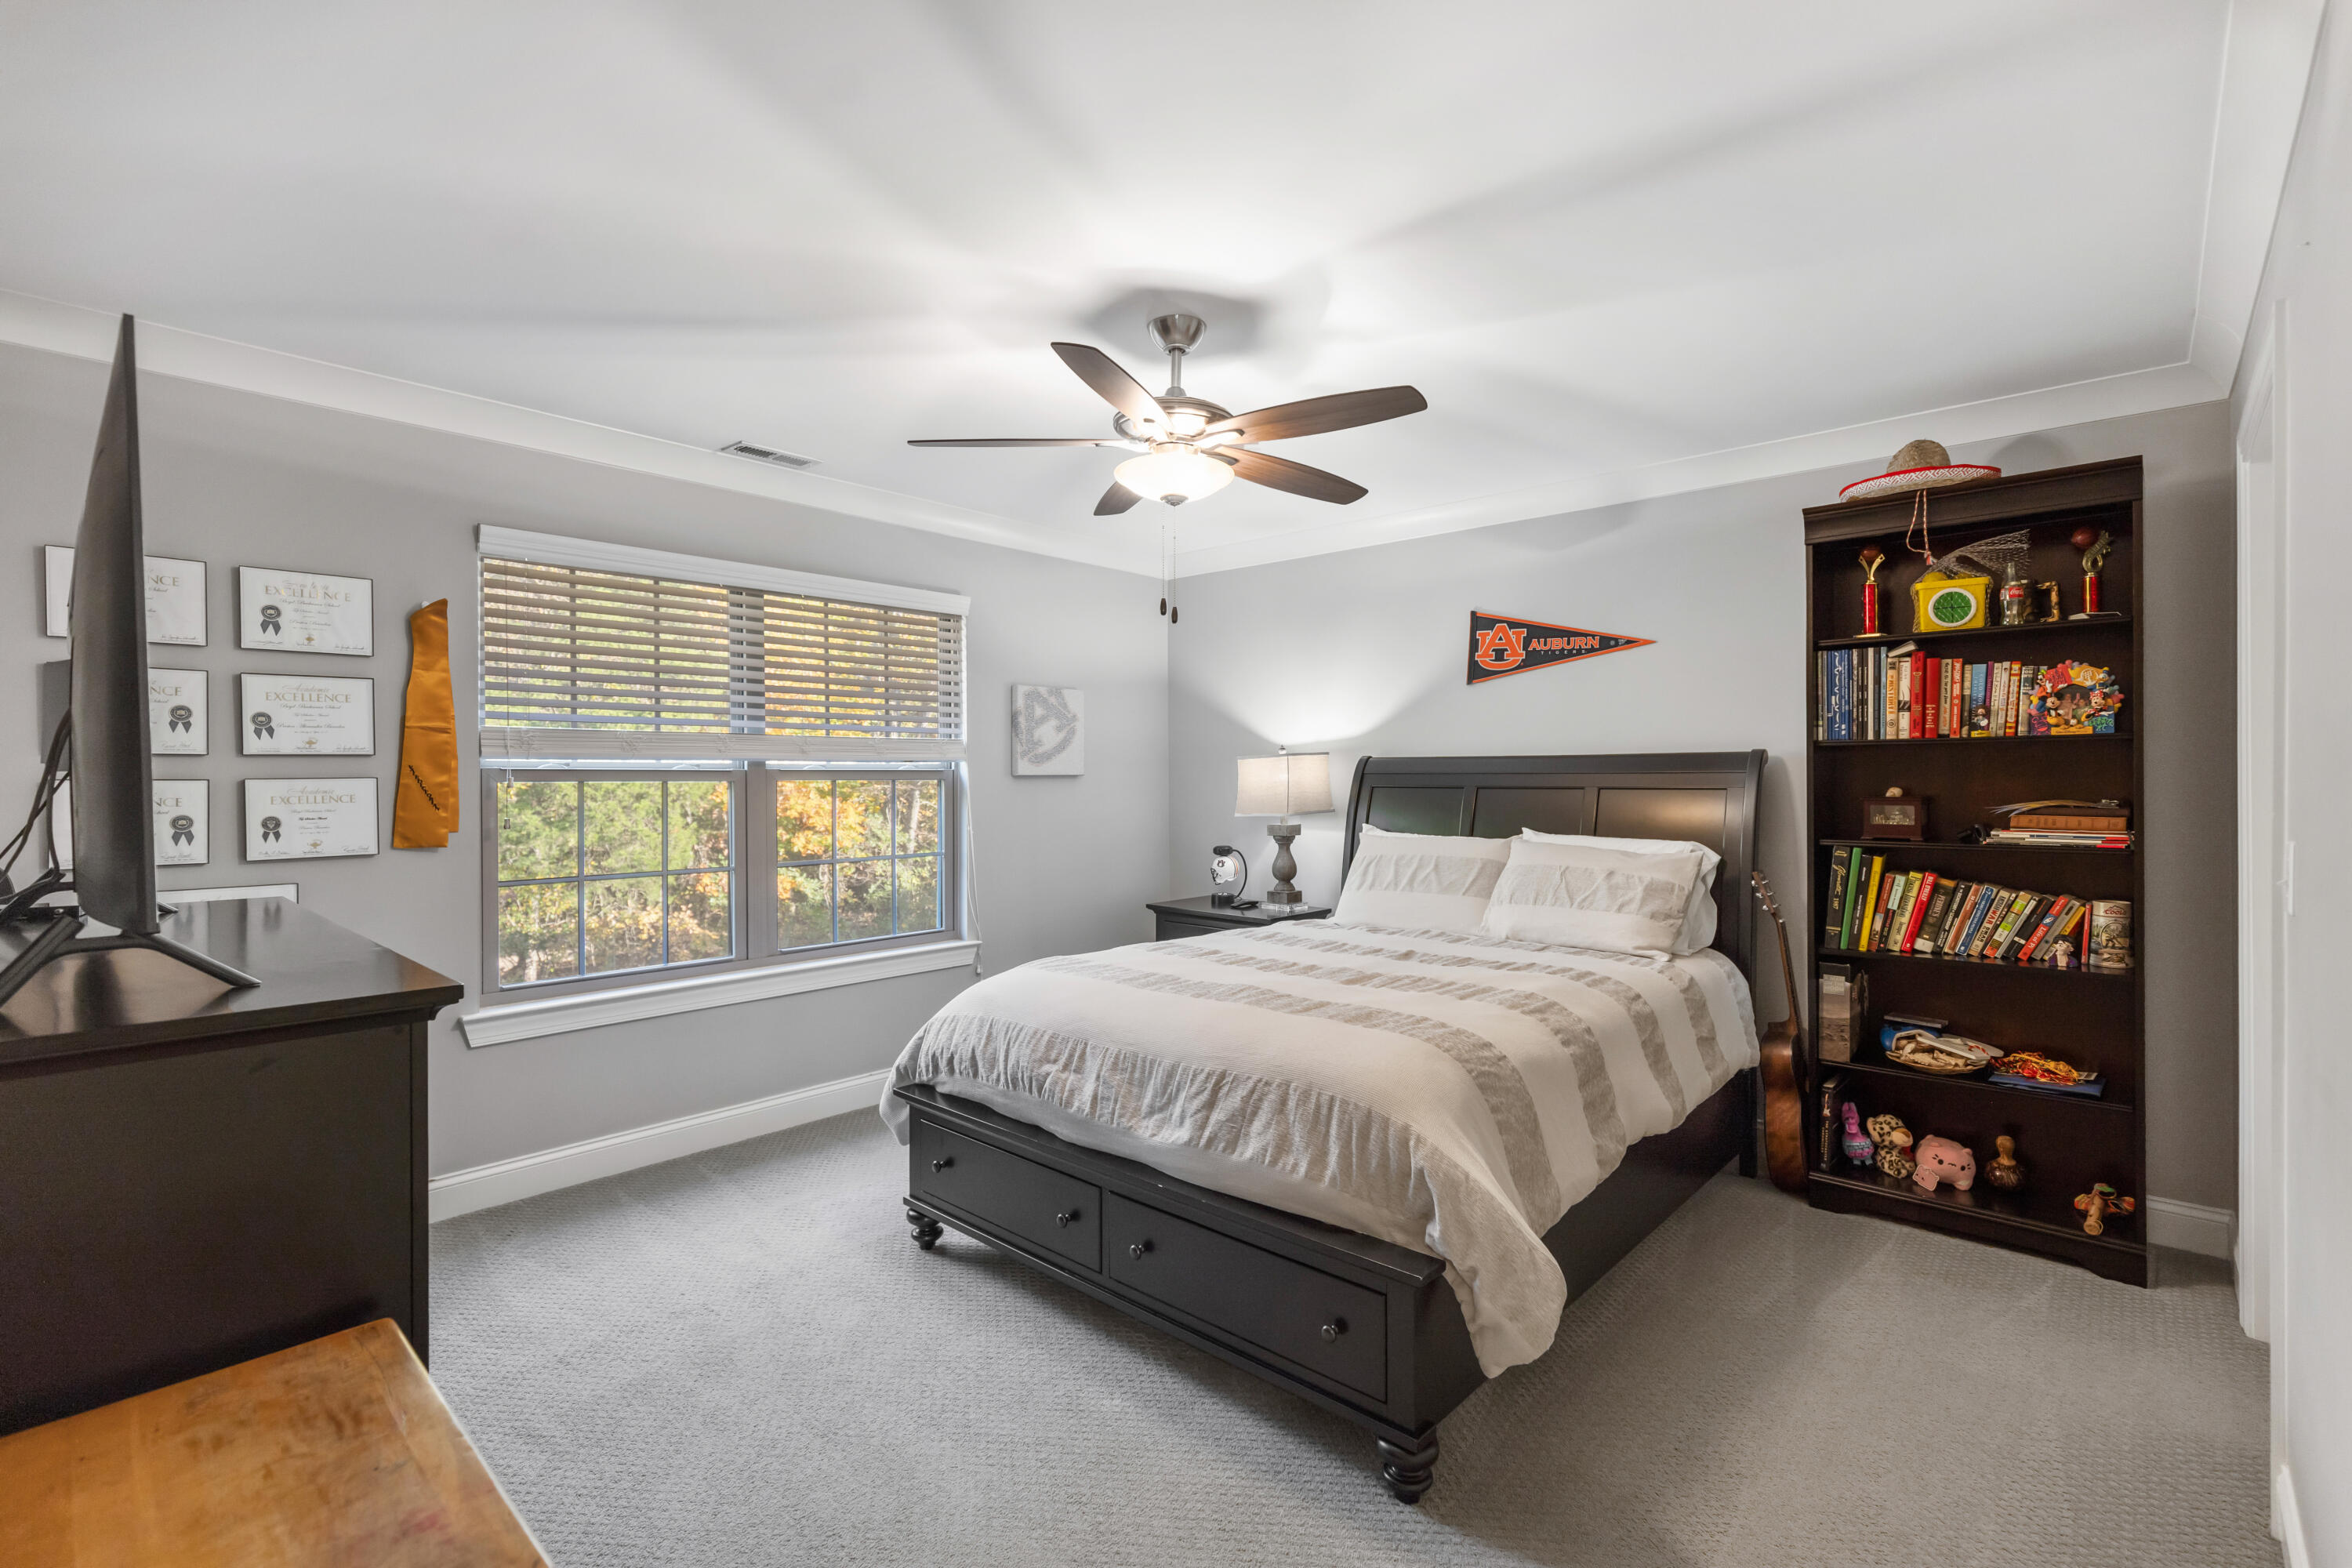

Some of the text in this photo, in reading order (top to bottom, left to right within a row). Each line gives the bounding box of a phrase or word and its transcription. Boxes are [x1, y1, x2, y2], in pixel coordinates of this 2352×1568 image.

[1528, 636, 1599, 651] AUBURN
[265, 691, 352, 702] EXCELLENCE
[270, 794, 356, 805] EXCELLENCE
[1986, 909, 1998, 924] WAR
[1980, 927, 1990, 942] OMAR
[2036, 927, 2046, 937] Life
